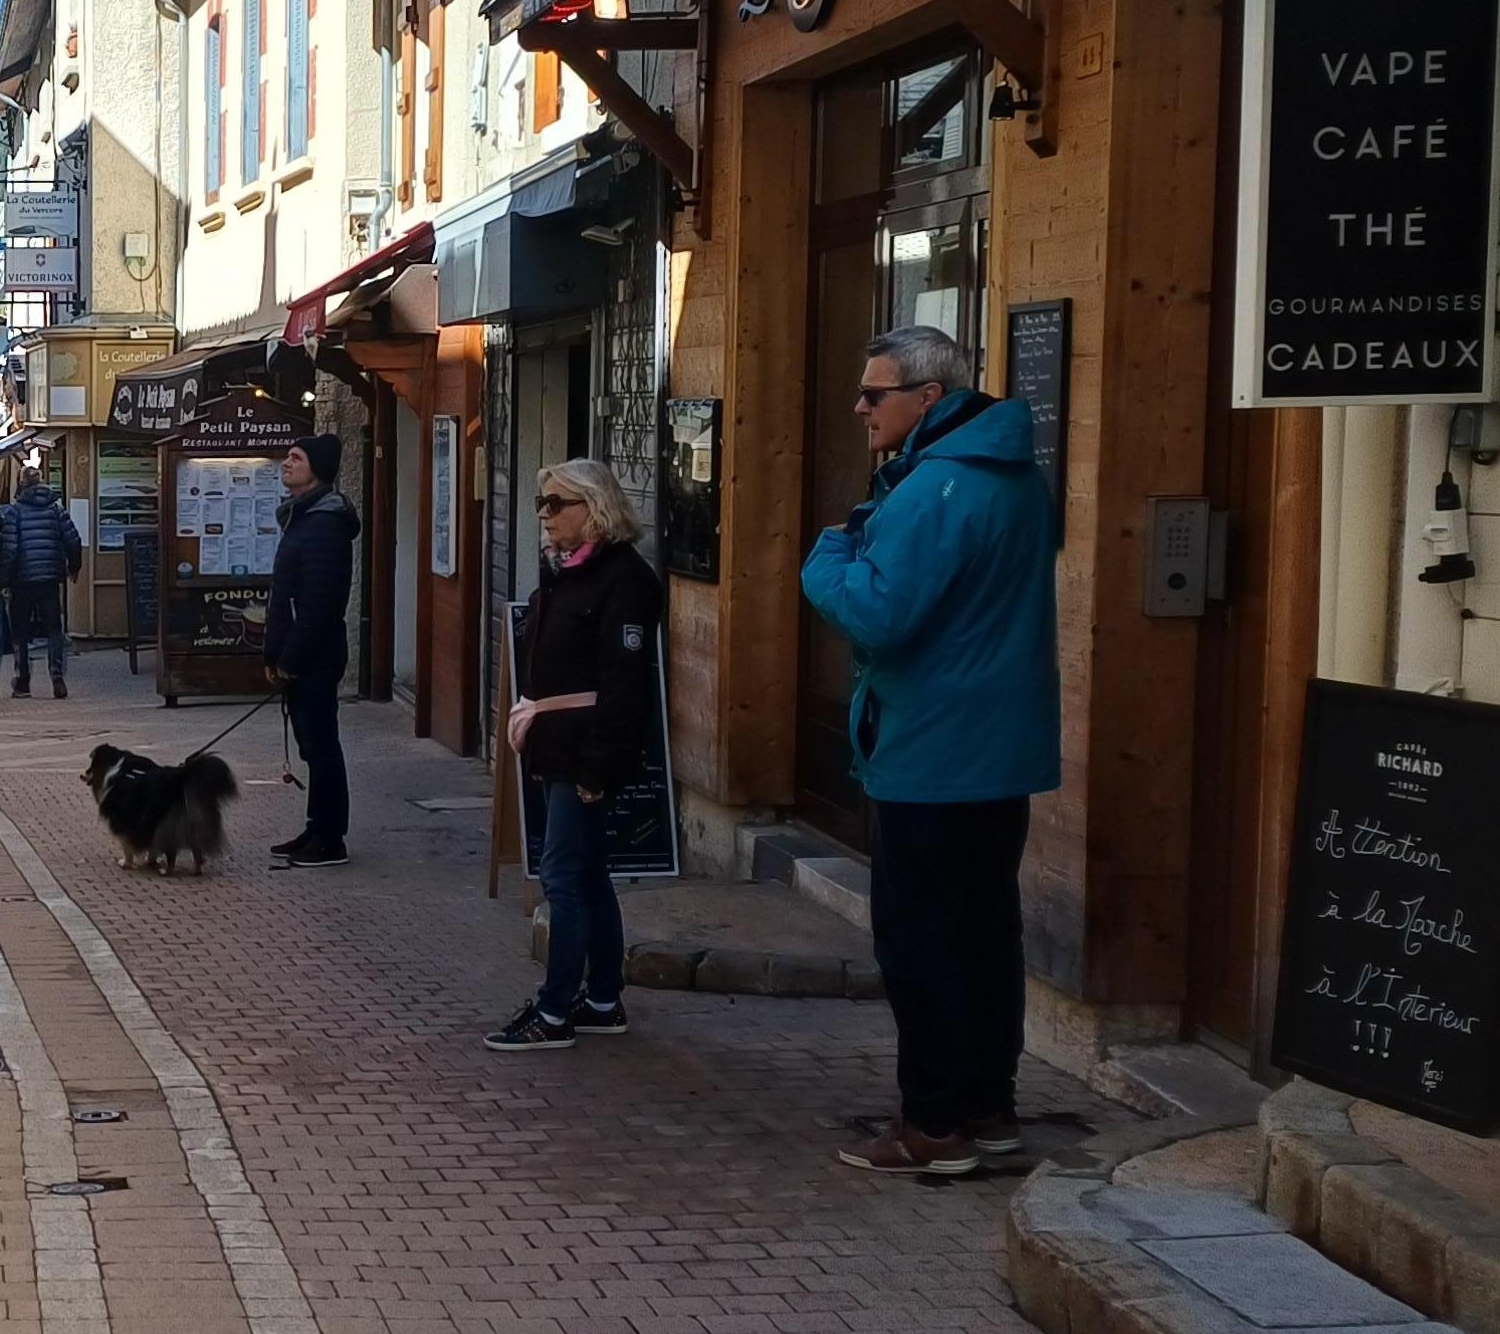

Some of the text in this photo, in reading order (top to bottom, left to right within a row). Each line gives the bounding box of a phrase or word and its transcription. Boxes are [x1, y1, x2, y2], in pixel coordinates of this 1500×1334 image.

[1321, 51, 1448, 86] VAPE
[1312, 117, 1449, 160] CAFÉ
[6, 195, 76, 204] La Coutellerie
[1328, 205, 1426, 247] THÉ
[8, 273, 73, 282] VICTORINOX
[1267, 293, 1483, 316] GOURMANDISES
[111, 351, 167, 363] Coutellerie
[1266, 338, 1480, 372] CADEAUX
[137, 385, 146, 408] Le
[237, 406, 254, 417] Le
[200, 421, 292, 435] Petit Paysan
[182, 438, 242, 447] RESTAURANT
[203, 589, 269, 603] FONDU
[1377, 752, 1444, 777] RICHARD
[1316, 890, 1343, 921] à
[1352, 889, 1393, 930] la
[1304, 966, 1339, 999] à
